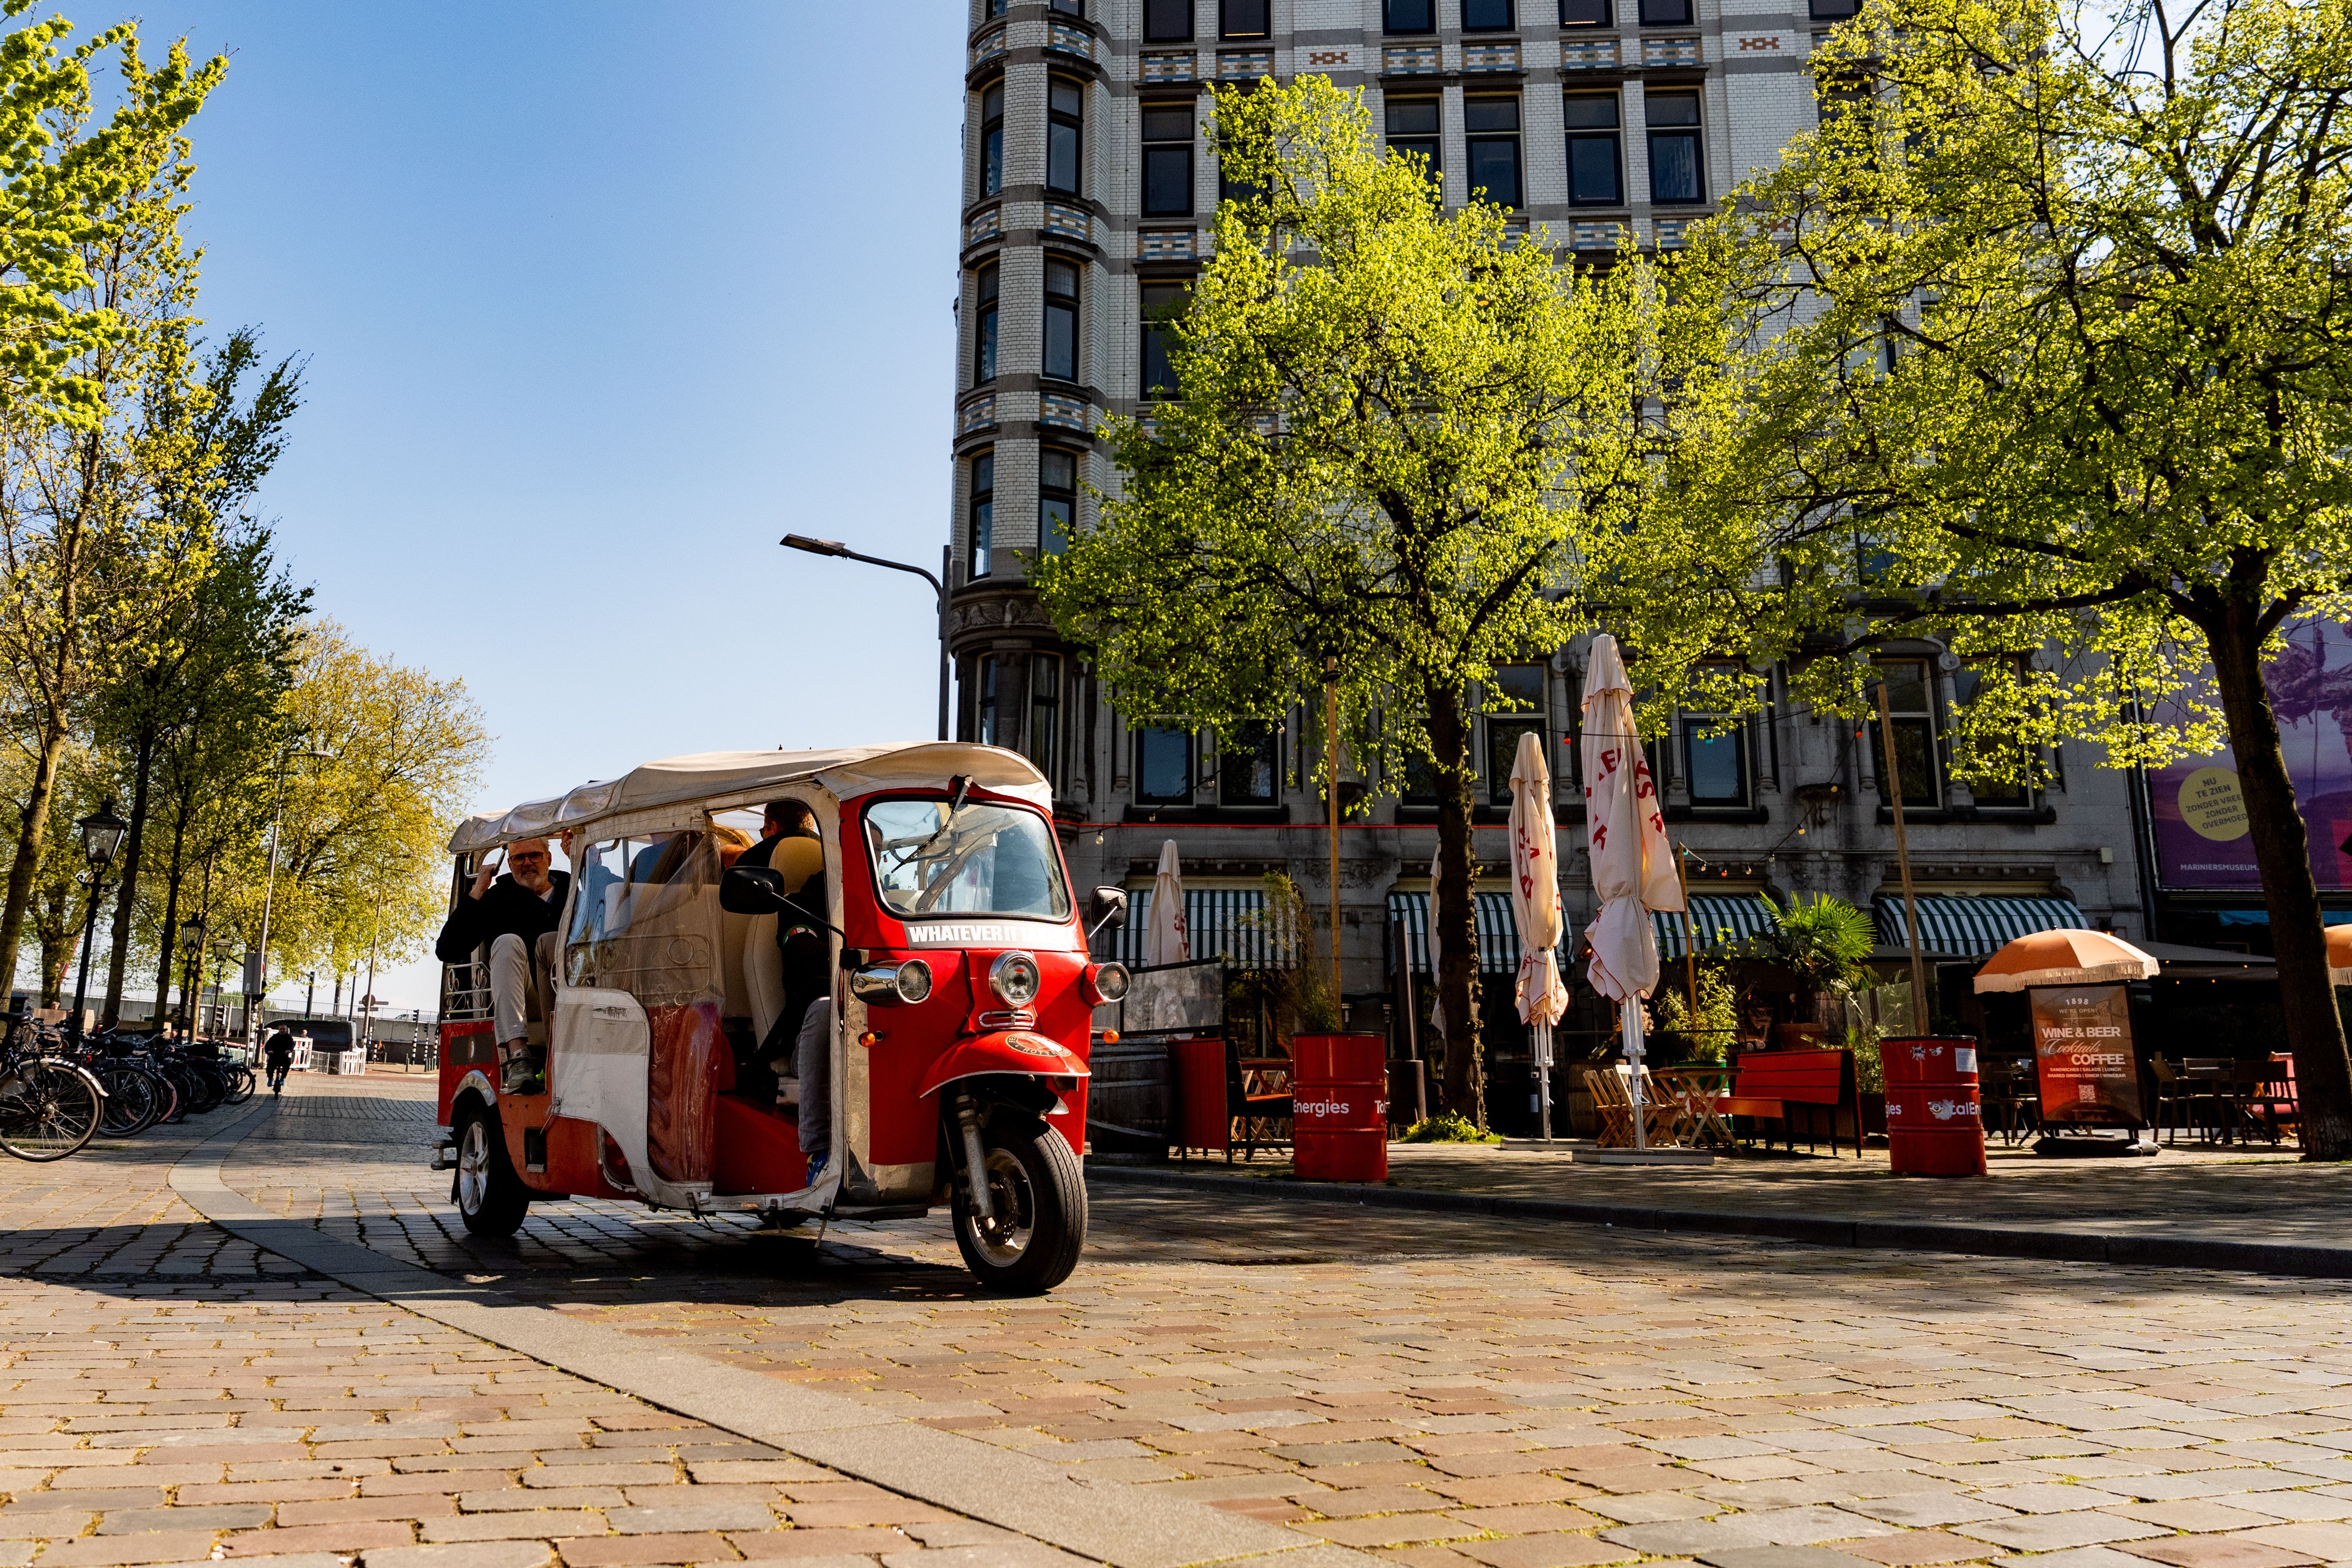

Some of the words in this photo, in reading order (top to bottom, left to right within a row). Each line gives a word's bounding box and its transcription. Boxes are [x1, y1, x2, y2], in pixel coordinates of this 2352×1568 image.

[2202, 777, 2216, 786] NU
[2195, 790, 2208, 798] TE
[2209, 784, 2231, 795] ZIEN
[2186, 799, 2219, 812] ZONDER
[2220, 794, 2242, 804] VREE
[2205, 804, 2238, 819] ZONDER
[2202, 813, 2248, 829] OVERMOED
[908, 925, 1003, 943] WHATEVER
[1003, 925, 1018, 942] IT
[2042, 1028, 2074, 1038] WINE
[2075, 1027, 2085, 1037] &
[2086, 1027, 2121, 1037] BEER
[2043, 1038, 2102, 1054] Cocktails
[2071, 1054, 2125, 1065] COFFEE
[1293, 1099, 1349, 1117] Energies
